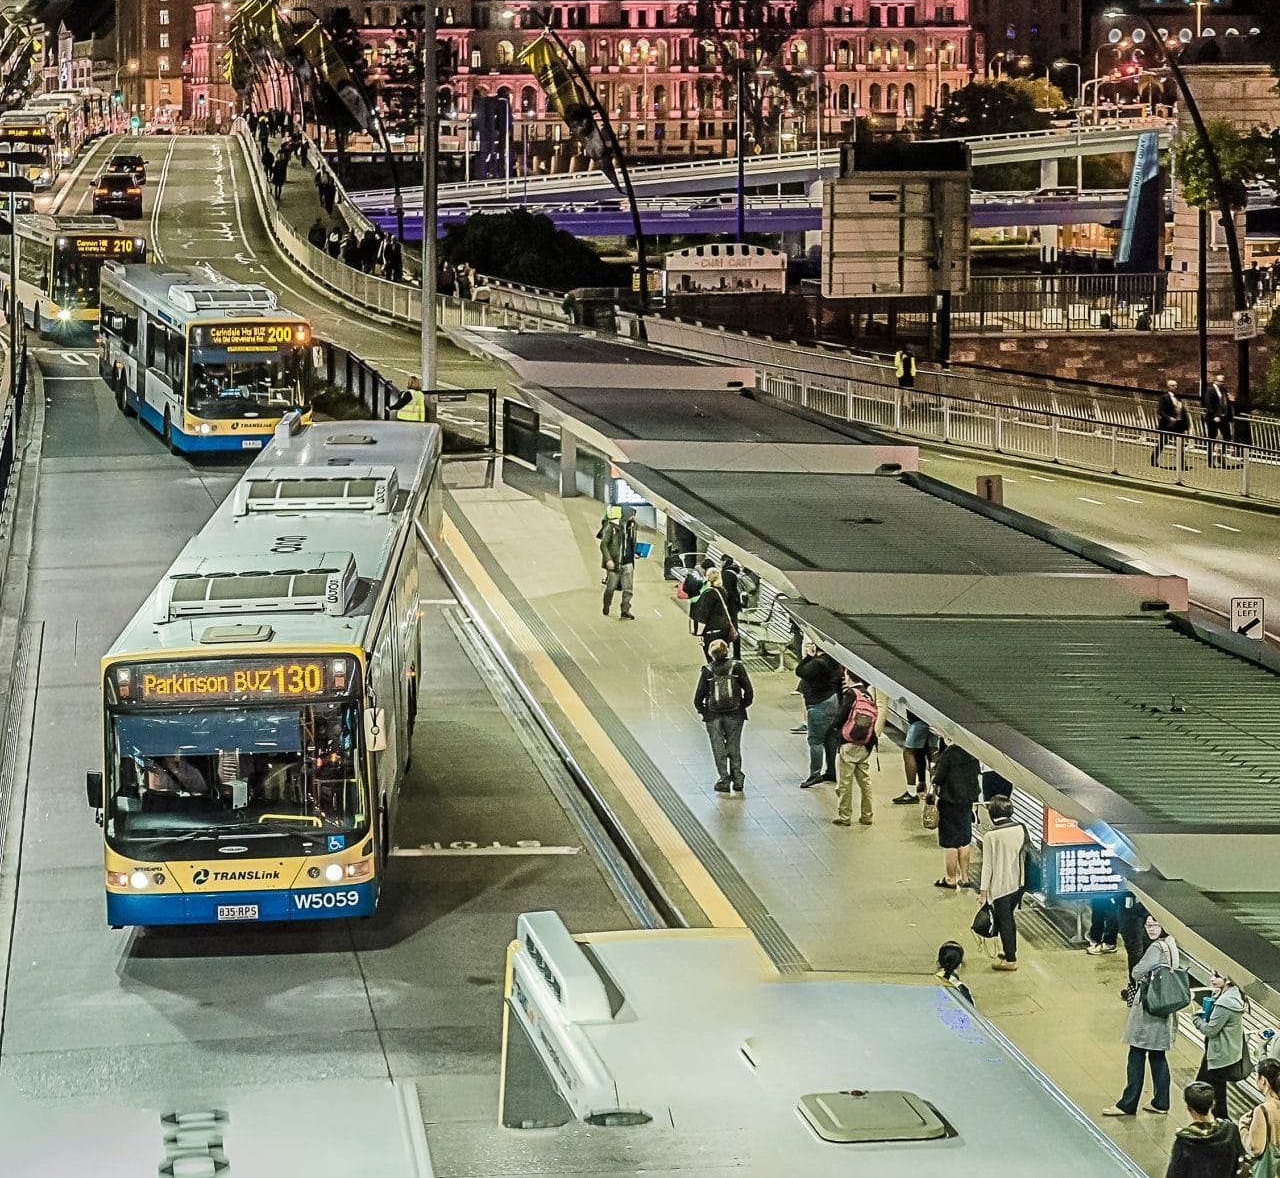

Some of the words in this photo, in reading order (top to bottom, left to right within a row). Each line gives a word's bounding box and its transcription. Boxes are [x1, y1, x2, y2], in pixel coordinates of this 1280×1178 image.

[1133, 162, 1142, 187] NORTH
[1138, 139, 1146, 160] QUAY
[113, 239, 133, 253] 210
[700, 258, 723, 268] CHAI
[210, 328, 240, 337] Carindale
[253, 327, 266, 336] BUZ
[268, 326, 292, 343] 200
[144, 673, 228, 695] Parkinson
[234, 670, 272, 691] BUZ
[272, 663, 321, 695] 130
[213, 869, 280, 881] TRANSLink
[295, 891, 359, 910] W5059
